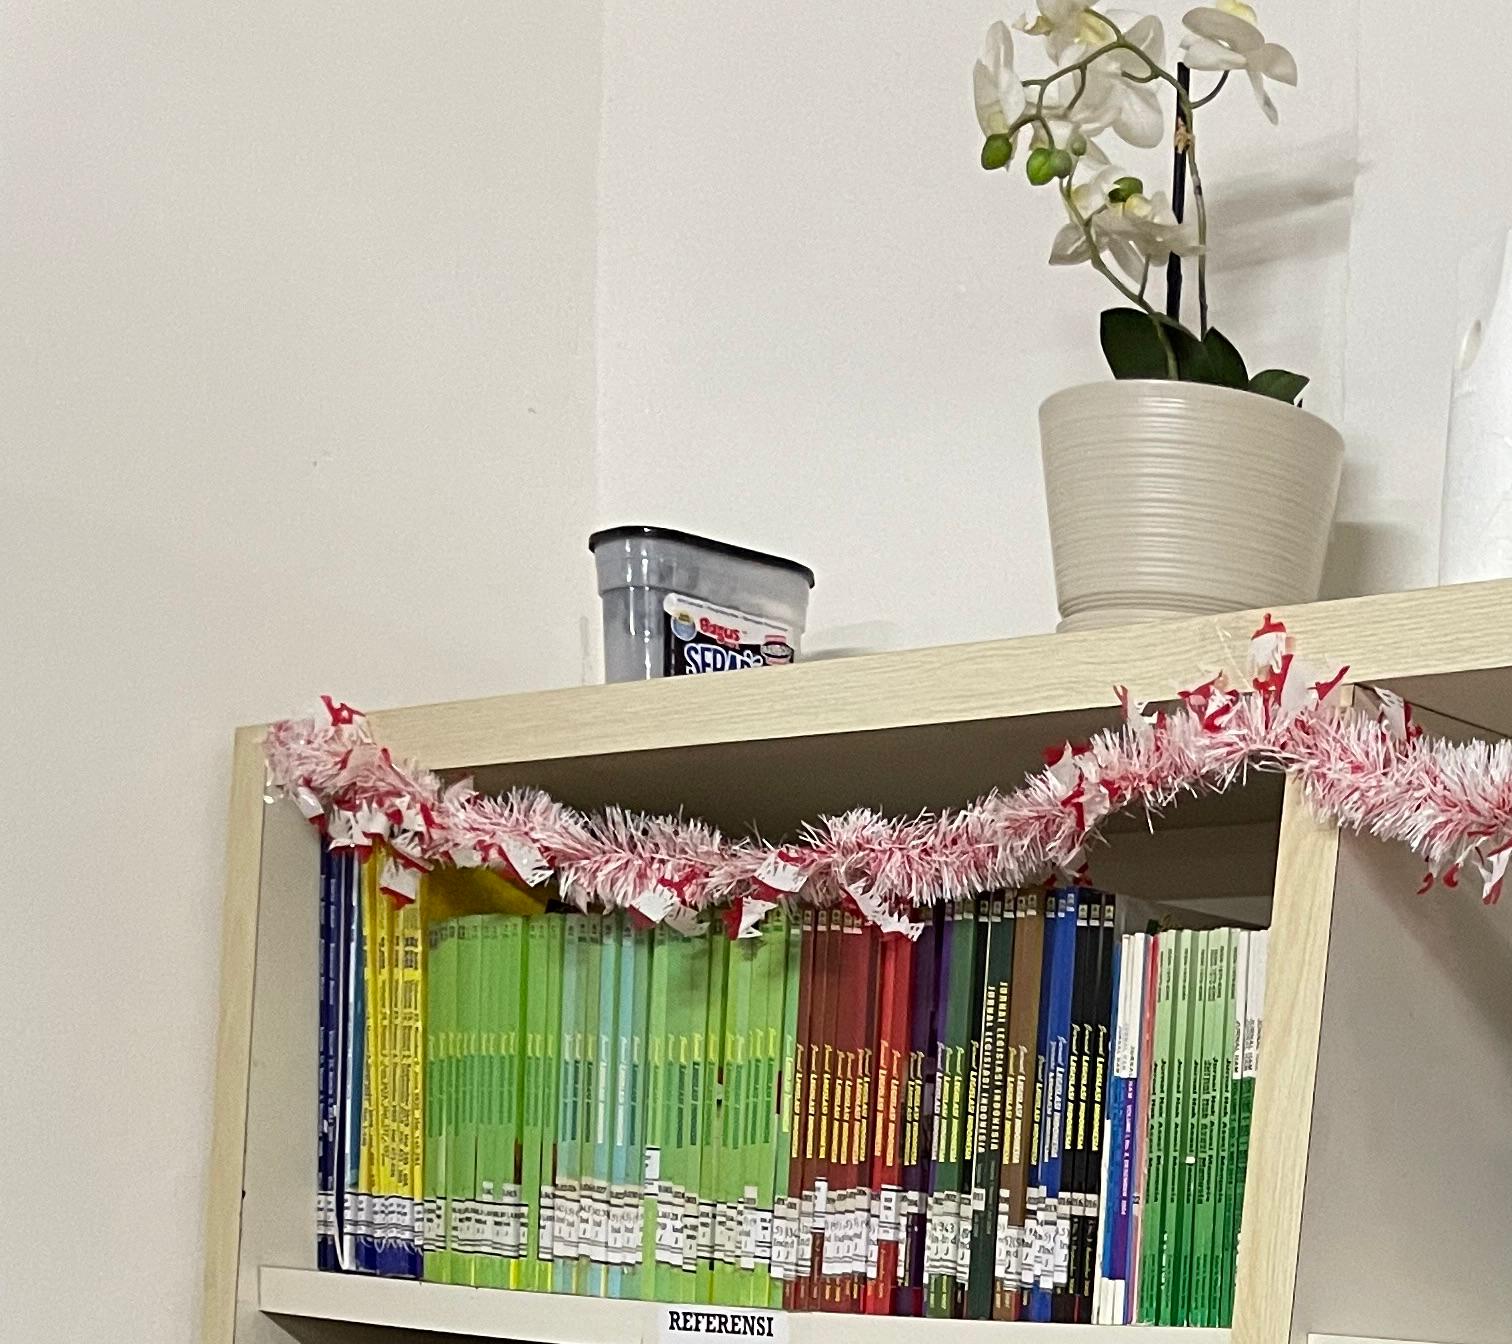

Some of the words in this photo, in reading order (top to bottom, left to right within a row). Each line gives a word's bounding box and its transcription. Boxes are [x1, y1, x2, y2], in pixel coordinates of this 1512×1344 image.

[700, 617, 743, 648] Bagus
[985, 986, 995, 1027] JURNAL
[998, 982, 1008, 1023] JURNAL
[982, 1032, 993, 1089] LEGISLASI
[994, 1028, 1005, 1085] LEGISLASI
[978, 1093, 989, 1153] INDONESIA
[990, 1089, 1002, 1150] INDONESIA
[669, 1310, 784, 1337] REFERENSI
